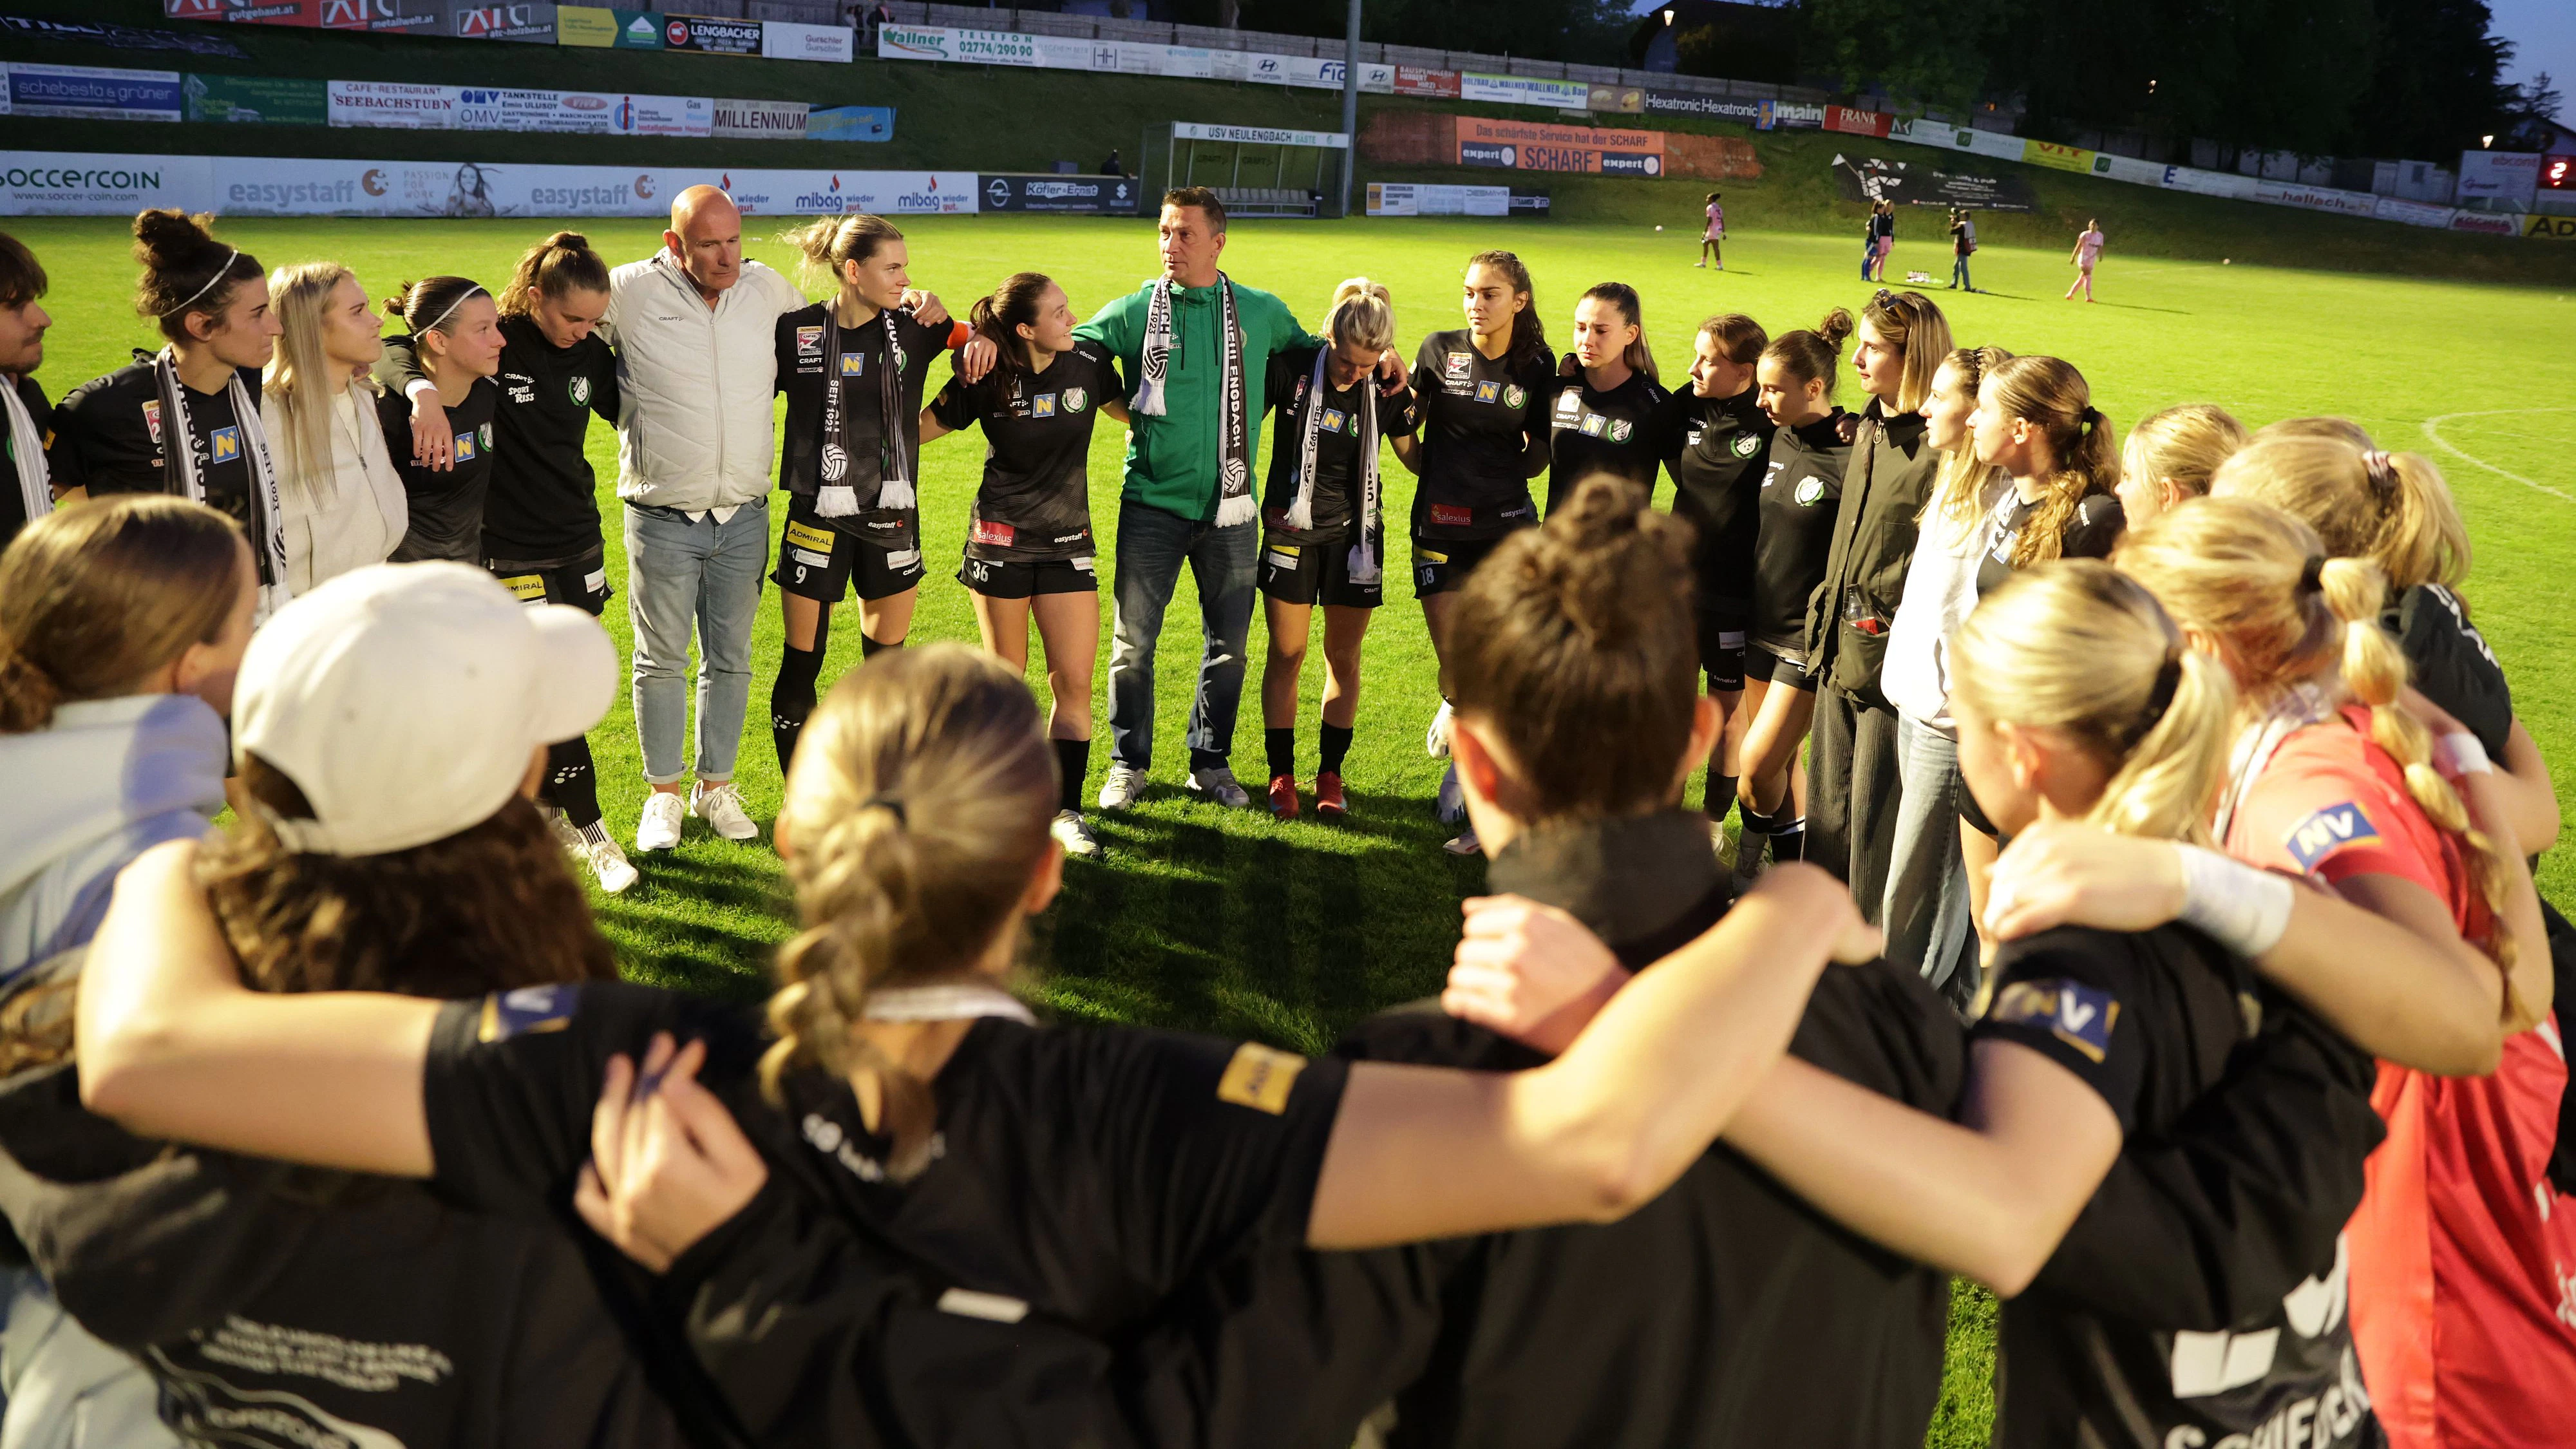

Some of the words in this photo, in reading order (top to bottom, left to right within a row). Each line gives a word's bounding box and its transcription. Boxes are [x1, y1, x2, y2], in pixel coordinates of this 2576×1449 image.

[690, 24, 760, 39] LENGBACHER
[882, 30, 945, 46] Wallner
[1019, 45, 1032, 57] 90
[19, 79, 104, 97] schebesta
[118, 84, 173, 102] grüner
[1527, 81, 1560, 94] WALLNER
[502, 91, 558, 101] TANKSTELLE
[687, 100, 701, 109] Gas
[1645, 93, 1701, 113] Hexatronic
[1701, 98, 1759, 118] Hexatronic
[460, 108, 500, 123] OMV
[714, 109, 808, 130] MILLENNIUM
[1839, 108, 1877, 126] FRANK
[1208, 128, 1227, 138] USV
[1228, 128, 1292, 142] NEULENGBACH
[1476, 124, 1493, 137] Das
[1495, 125, 1537, 140] schärfste
[1539, 129, 1572, 142] Service
[1575, 131, 1589, 144] hat
[1592, 133, 1607, 146] der
[1609, 133, 1648, 147] SCHARF
[1463, 148, 1500, 160] expert
[1524, 147, 1594, 172] SCHARF
[1602, 158, 1643, 169] expert
[229, 180, 355, 209] easystaff
[531, 184, 629, 209] easystaff
[1067, 184, 1097, 196] Ernst
[737, 194, 770, 204] wieder
[795, 192, 842, 212] mibag
[846, 194, 875, 204] wieder
[898, 192, 940, 211] mibag
[942, 194, 969, 203] wieder
[1148, 313, 1159, 335] 1923
[1079, 350, 1097, 363] ebcont
[504, 373, 528, 382] CRAFT
[508, 386, 530, 396] SPORT
[515, 393, 535, 404] RISS
[828, 379, 839, 406] SEIT
[824, 406, 835, 433] 1923
[1308, 431, 1319, 453] 1923
[259, 442, 275, 477] SEIT
[867, 519, 896, 529] easystaff
[1437, 512, 1472, 523] salexius
[789, 527, 832, 546] ADMIRAL
[978, 530, 1012, 544] salexius
[1054, 532, 1083, 544] easystaff
[795, 565, 808, 584] 9
[972, 560, 989, 583] 36
[1268, 566, 1278, 583] 7
[1419, 567, 1435, 587] 18
